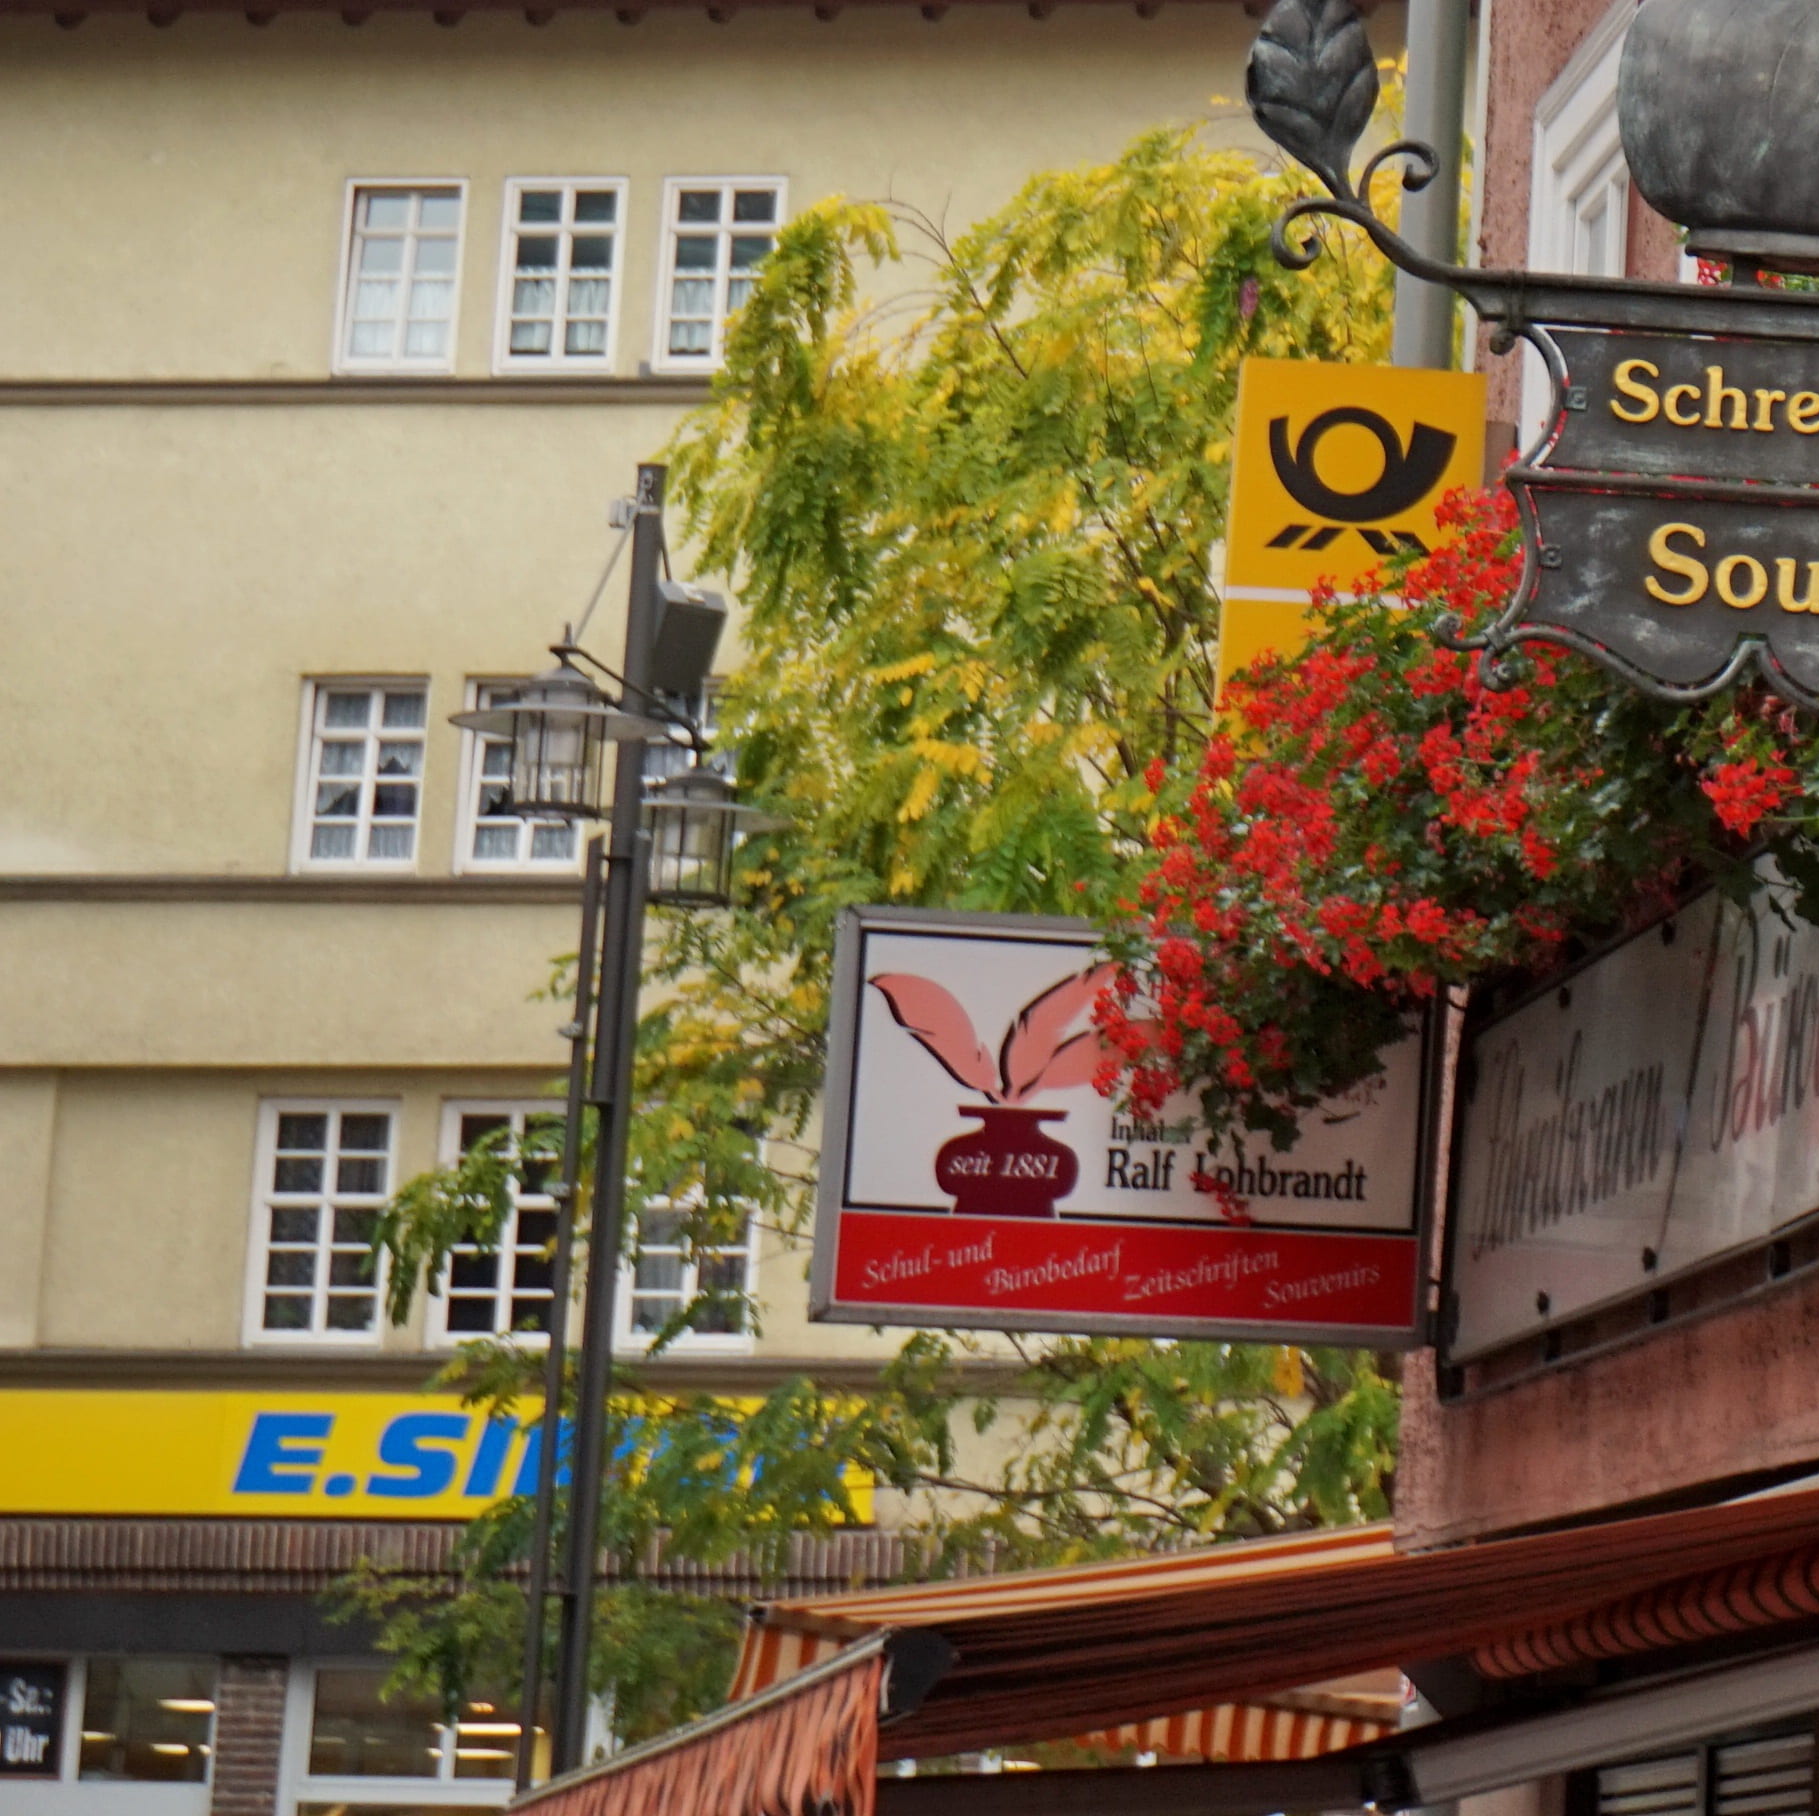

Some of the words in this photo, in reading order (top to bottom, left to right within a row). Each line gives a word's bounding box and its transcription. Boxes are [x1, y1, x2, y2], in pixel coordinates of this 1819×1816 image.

[948, 1153, 992, 1176] seit
[1000, 1154, 1060, 1180] 1881
[1106, 1148, 1176, 1191] Ralf
[1193, 1151, 1367, 1201] Lohbrandt
[862, 1244, 942, 1288] Schul-
[947, 1230, 996, 1268] und
[984, 1237, 1124, 1295] Bürobedarf
[1123, 1248, 1281, 1301] Zeitschriften
[1261, 1264, 1382, 1309] Souvenirs
[4, 1725, 50, 1763] Uhr
